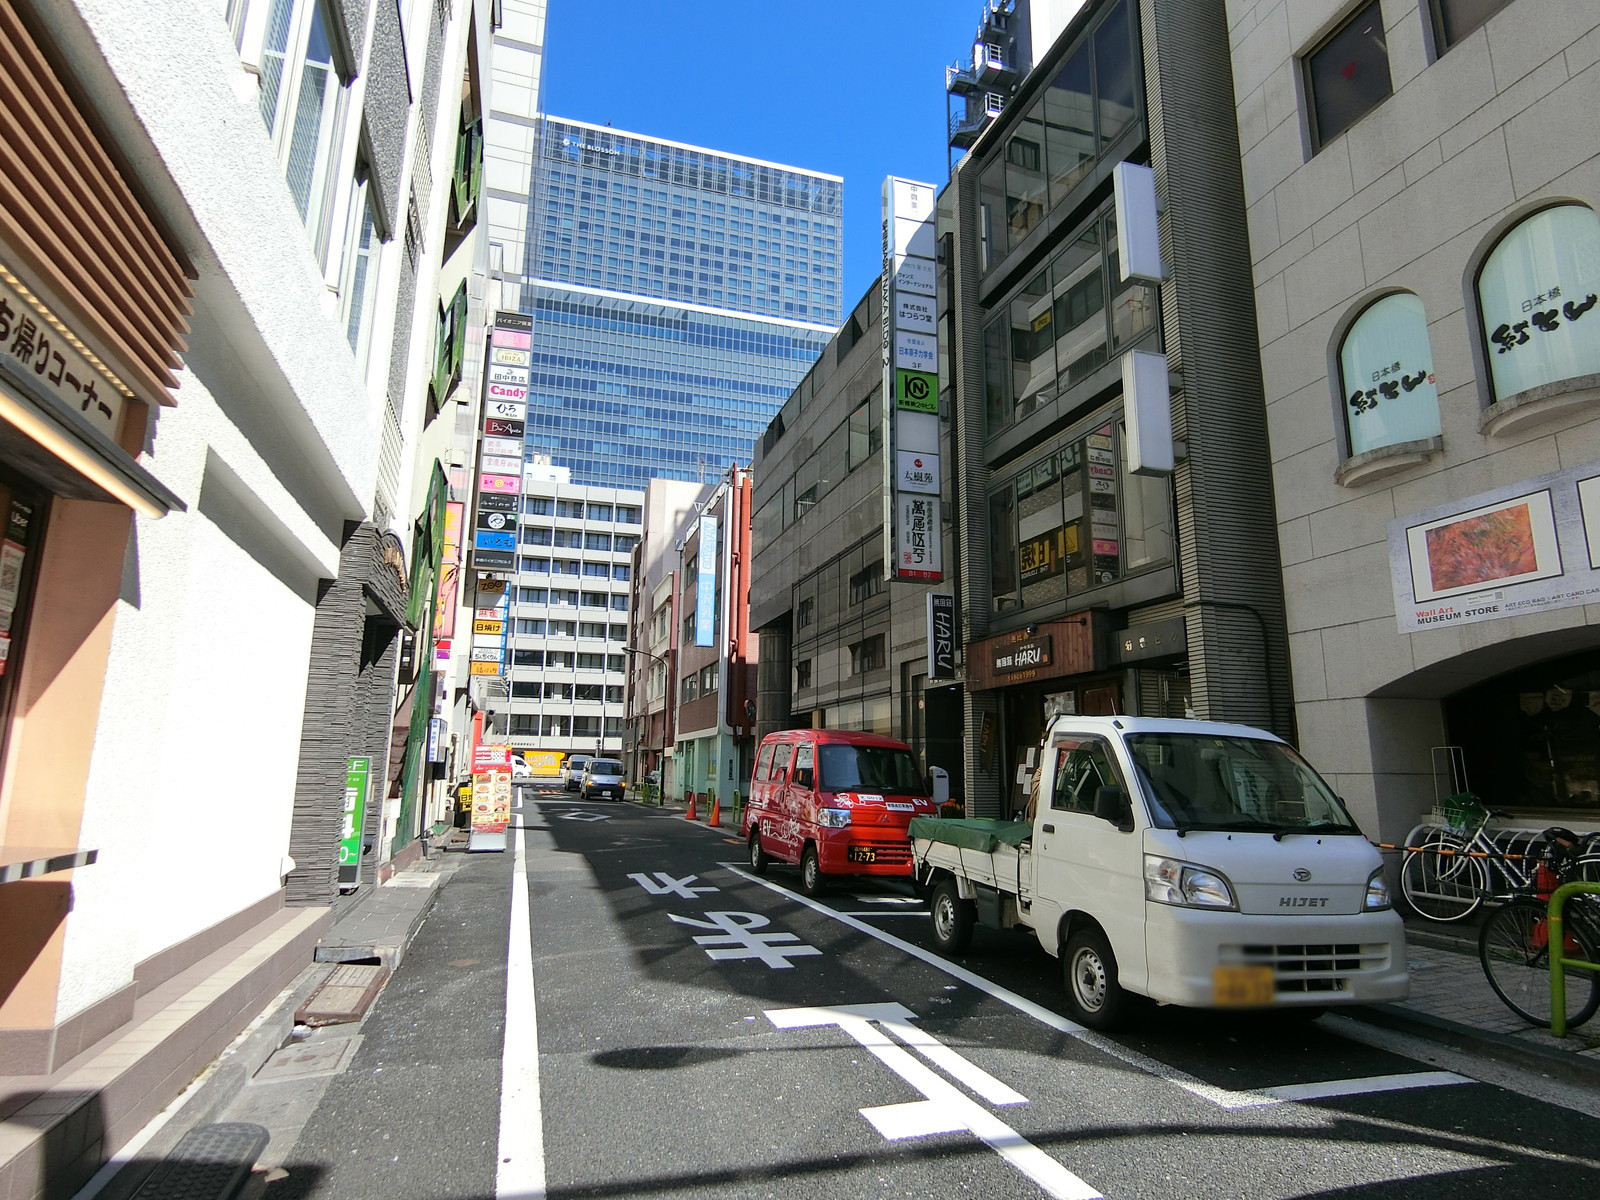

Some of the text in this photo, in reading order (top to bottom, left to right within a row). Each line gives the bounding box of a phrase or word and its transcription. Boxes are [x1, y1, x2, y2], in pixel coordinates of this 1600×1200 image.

[572, 141, 620, 156] THE BLOSSOM
[1521, 286, 1561, 313] 日本橋
[903, 303, 928, 313] 株式会社
[899, 310, 933, 323] はつらつ堂
[1371, 361, 1401, 382] 日本橋
[490, 385, 527, 399] Candy
[481, 581, 503, 591] ZOO
[1416, 606, 1454, 618] Wall Art
[1417, 612, 1462, 625] MUSEUM
[1465, 605, 1499, 617] STORE
[476, 623, 501, 632] 日焼け
[936, 612, 953, 670] HARU
[1014, 647, 1041, 667] HARU
[912, 798, 928, 807] EV
[762, 819, 772, 837] EV
[854, 852, 876, 862] 12-73
[1279, 897, 1329, 908] HIJET
